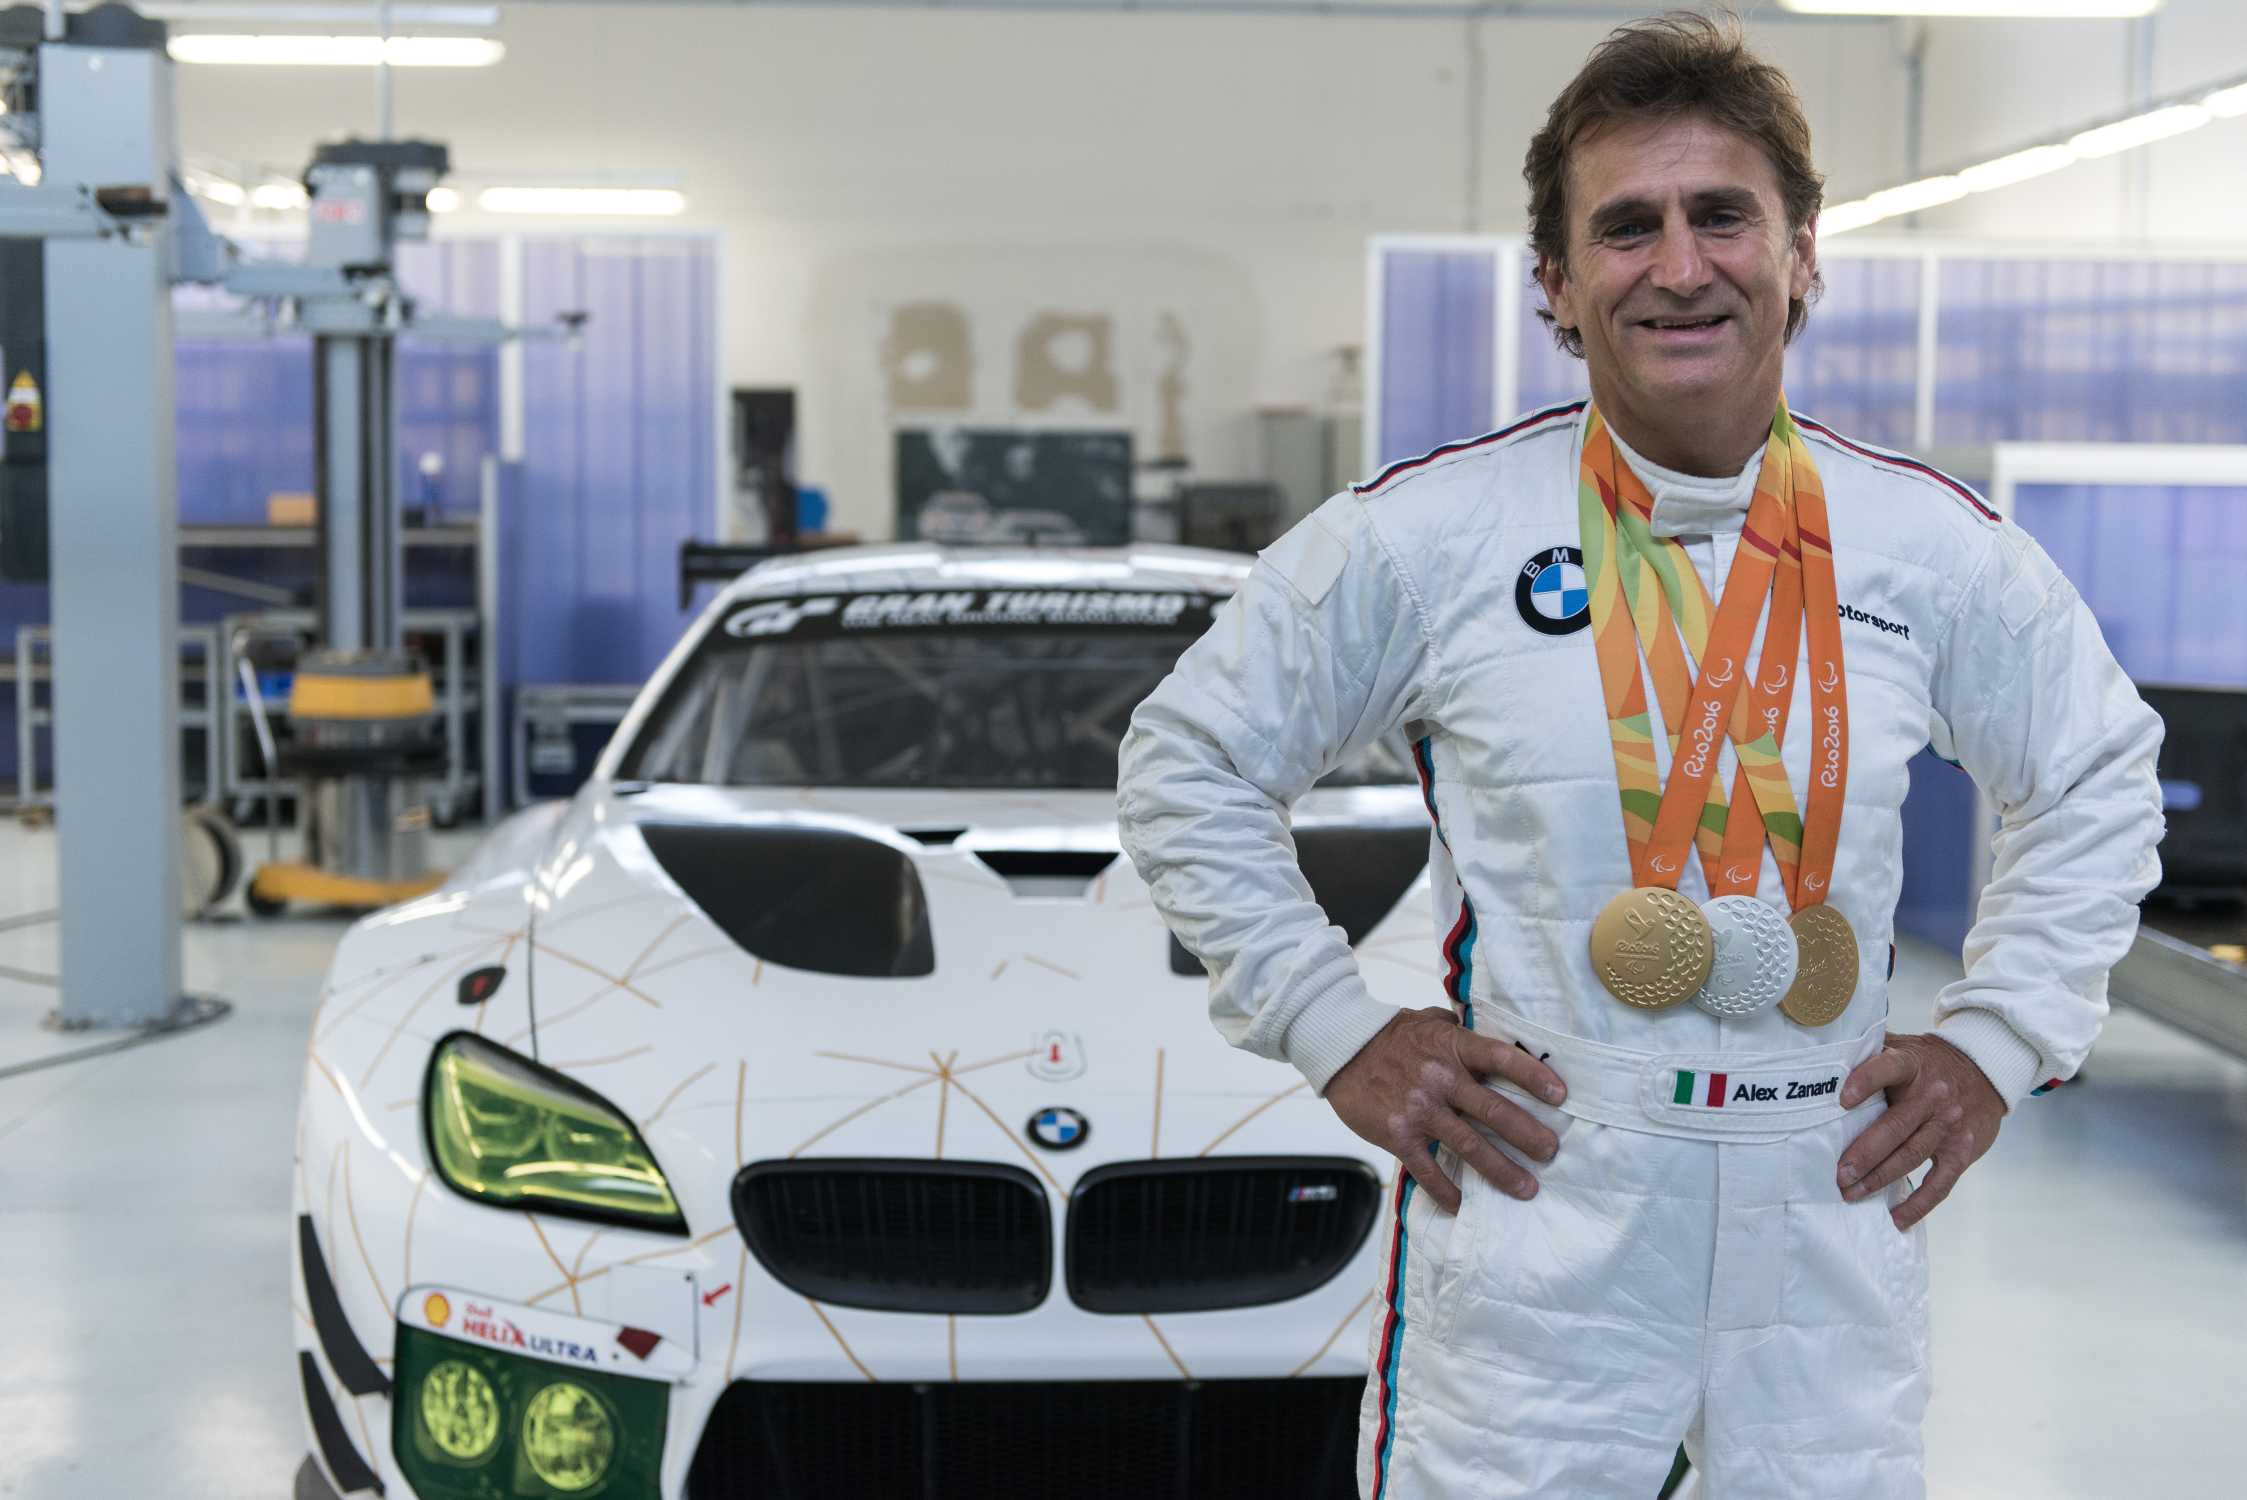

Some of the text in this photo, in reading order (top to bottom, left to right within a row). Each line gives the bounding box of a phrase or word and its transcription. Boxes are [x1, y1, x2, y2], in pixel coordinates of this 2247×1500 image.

[1523, 548, 1584, 578] BM
[842, 593, 975, 618] GRAN
[984, 591, 1186, 615] TURISMO
[1837, 604, 1910, 640] otorsport
[1683, 700, 1722, 778] Rio2016
[1820, 705, 1840, 788] Rio2016
[1732, 1077, 1839, 1101] Alex Zanardi
[463, 1319, 598, 1363] HELIX ULTRA
